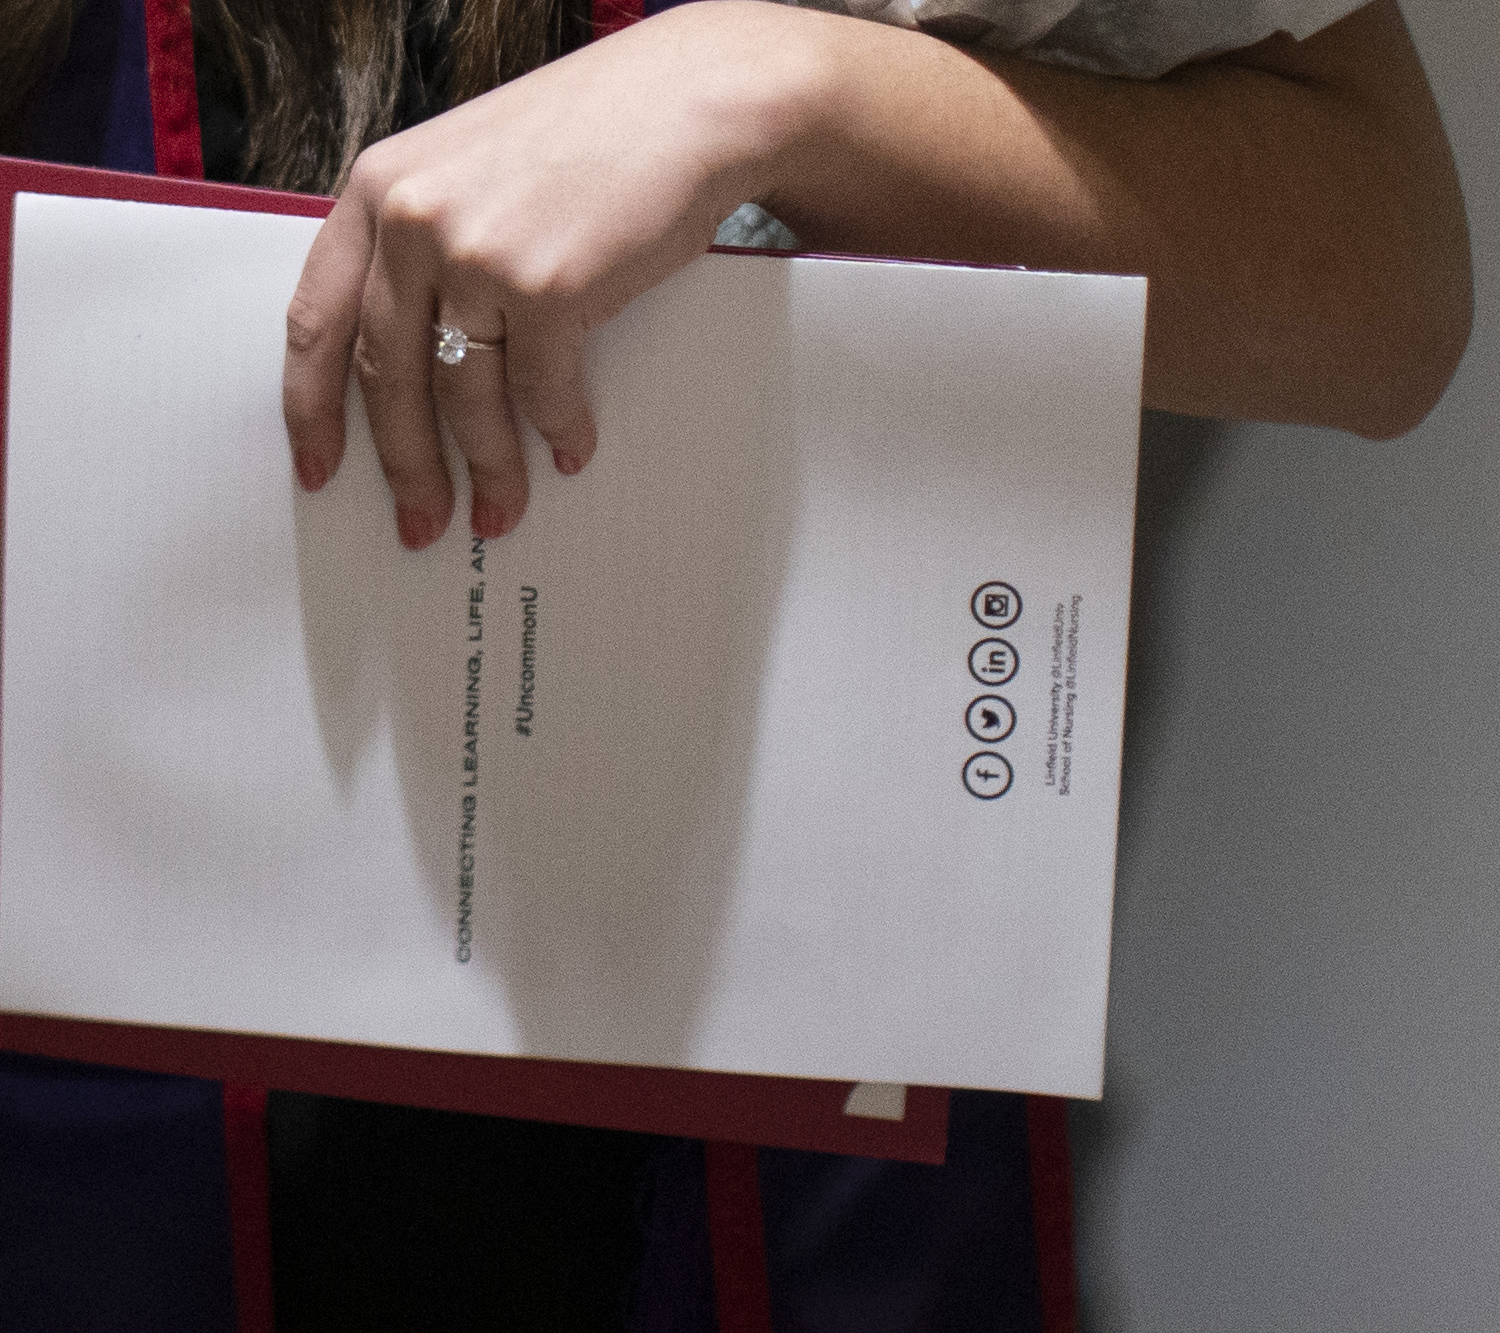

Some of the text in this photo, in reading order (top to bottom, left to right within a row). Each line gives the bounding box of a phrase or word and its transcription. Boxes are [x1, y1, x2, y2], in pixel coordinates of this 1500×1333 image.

[515, 585, 539, 737] #UncommonU
[1047, 682, 1063, 741] University
[1062, 692, 1078, 739] Nursing
[456, 537, 487, 963] CONNECTING LEARNING, LIFE, AN
[1045, 743, 1058, 787] Linfield
[1058, 755, 1073, 796] School
